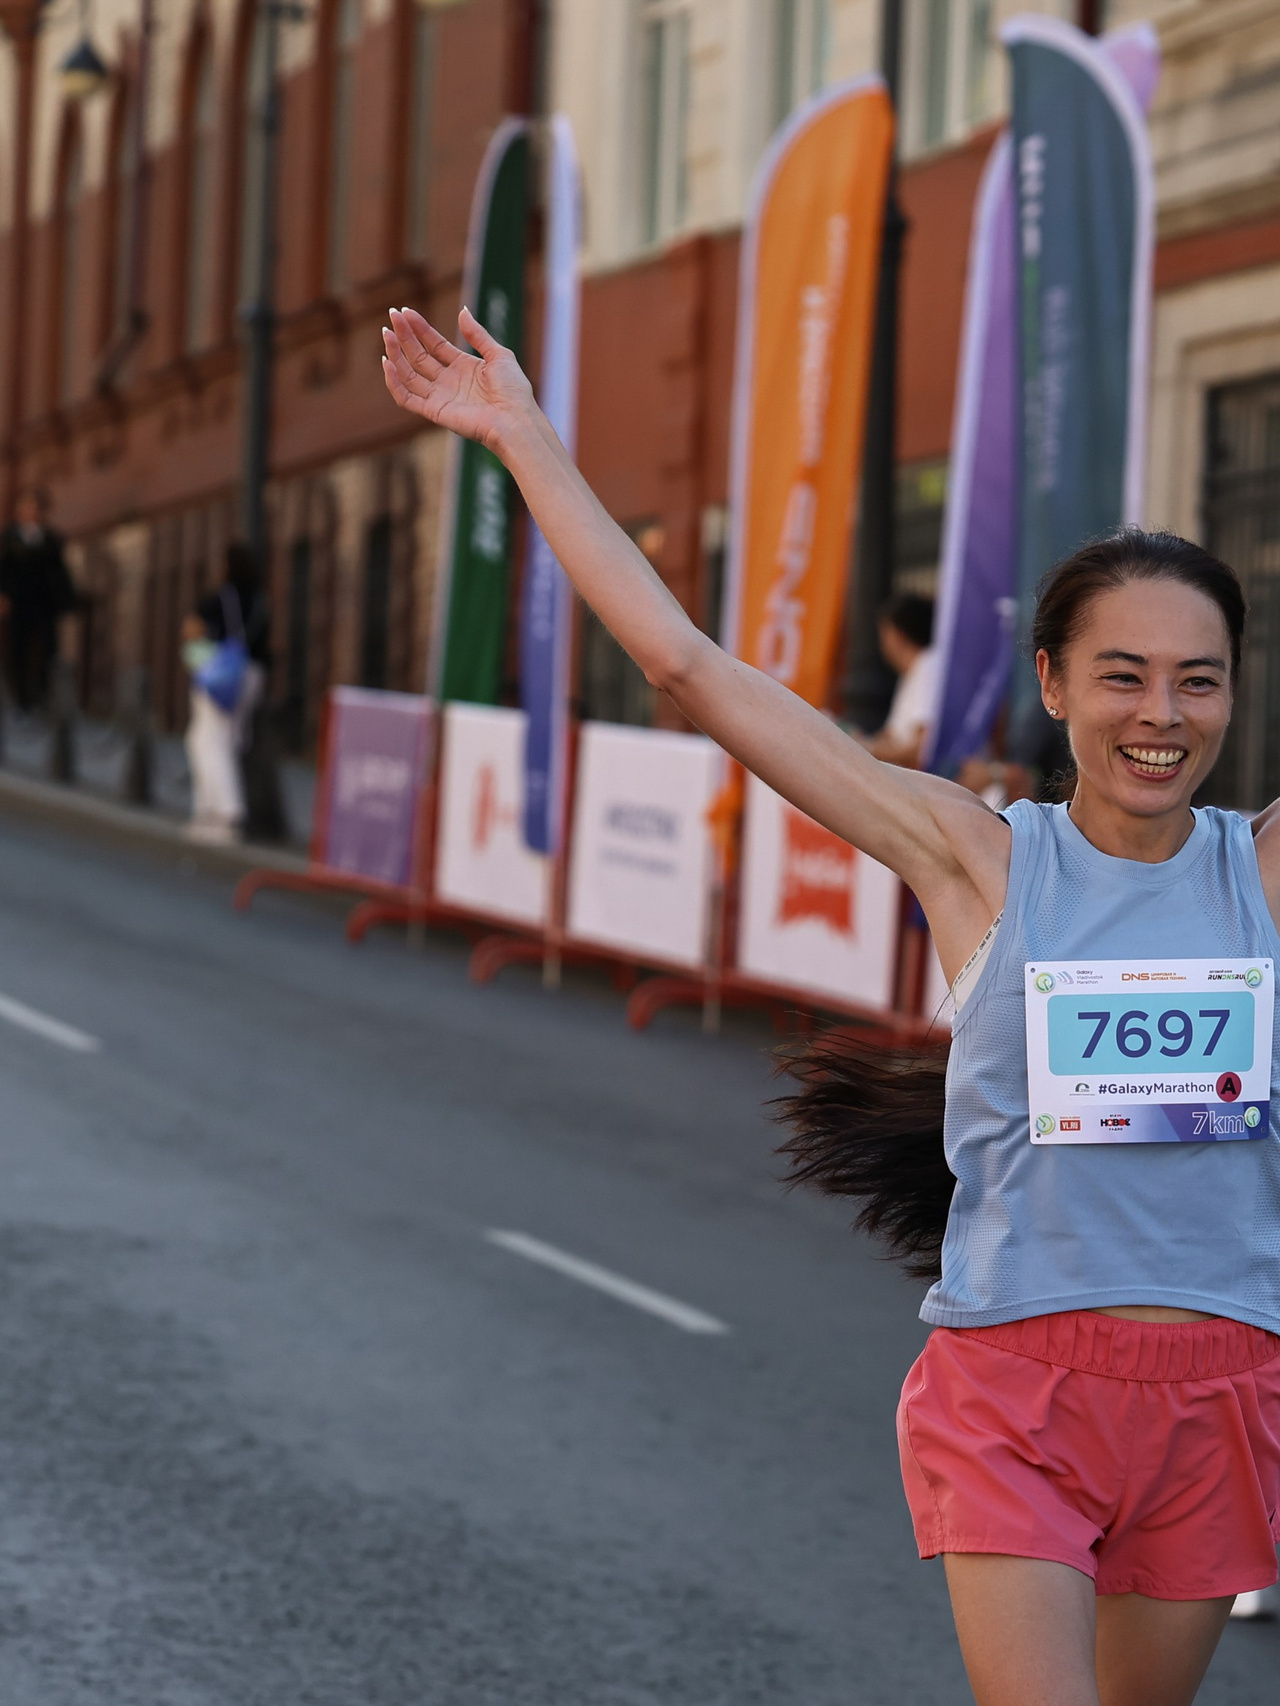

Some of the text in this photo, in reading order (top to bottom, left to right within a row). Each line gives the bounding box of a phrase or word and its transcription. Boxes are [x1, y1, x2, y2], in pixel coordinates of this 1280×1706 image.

[979, 940, 987, 950] ONE
[1121, 972, 1150, 981] DNS
[1077, 1009, 1231, 1059] 7697
[1098, 1081, 1215, 1096] #GalaxyMarathon
[1220, 1077, 1237, 1095] A
[1062, 1121, 1079, 1130] VL.RU
[1192, 1111, 1245, 1135] 7km
